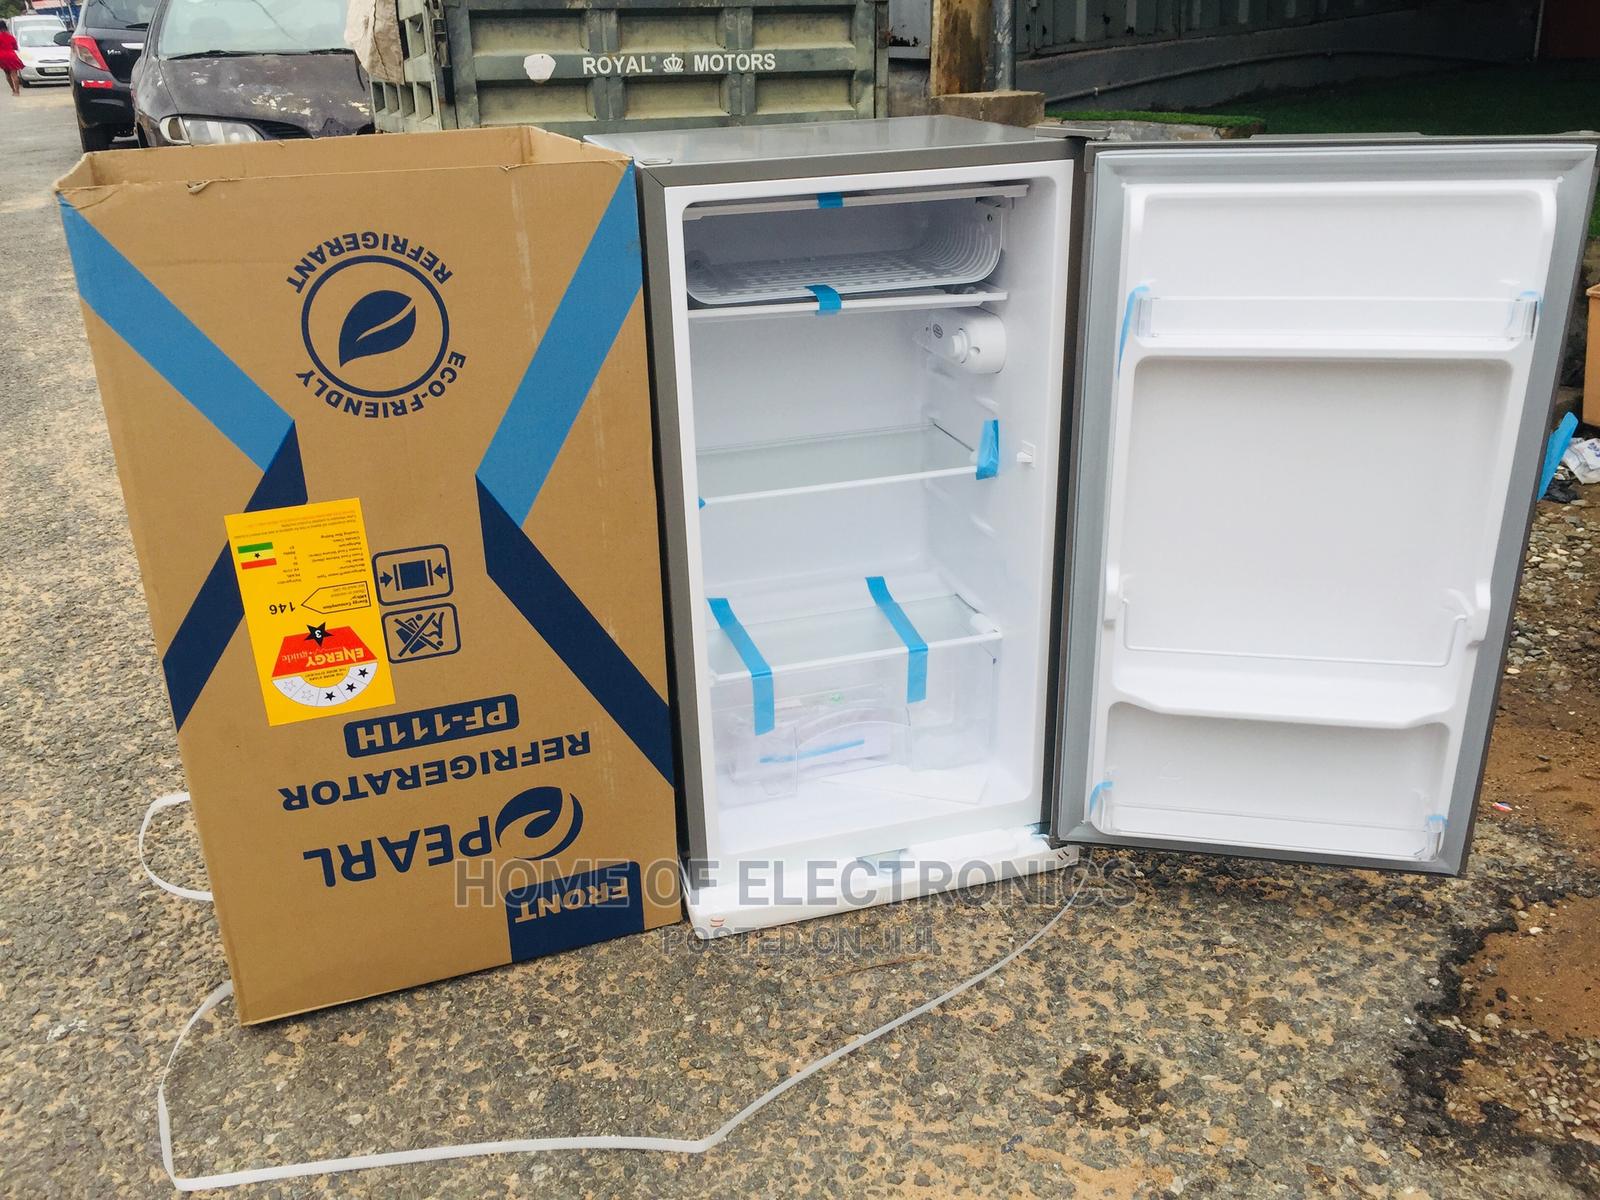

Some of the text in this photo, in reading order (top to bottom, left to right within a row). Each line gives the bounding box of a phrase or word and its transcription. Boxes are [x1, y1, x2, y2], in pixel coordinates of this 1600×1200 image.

[582, 53, 777, 76] ROYAL MOTORS
[286, 231, 454, 294] REFRIGERANT
[296, 351, 467, 419] ECO-FRIENDLY
[269, 602, 296, 615] 146
[305, 646, 366, 668] ENERGY
[314, 629, 322, 639] 3
[356, 701, 508, 751] PF-111H
[277, 731, 592, 812] REFRIGERATOR
[303, 815, 494, 888] PEARL
[514, 876, 629, 924] FRONT
